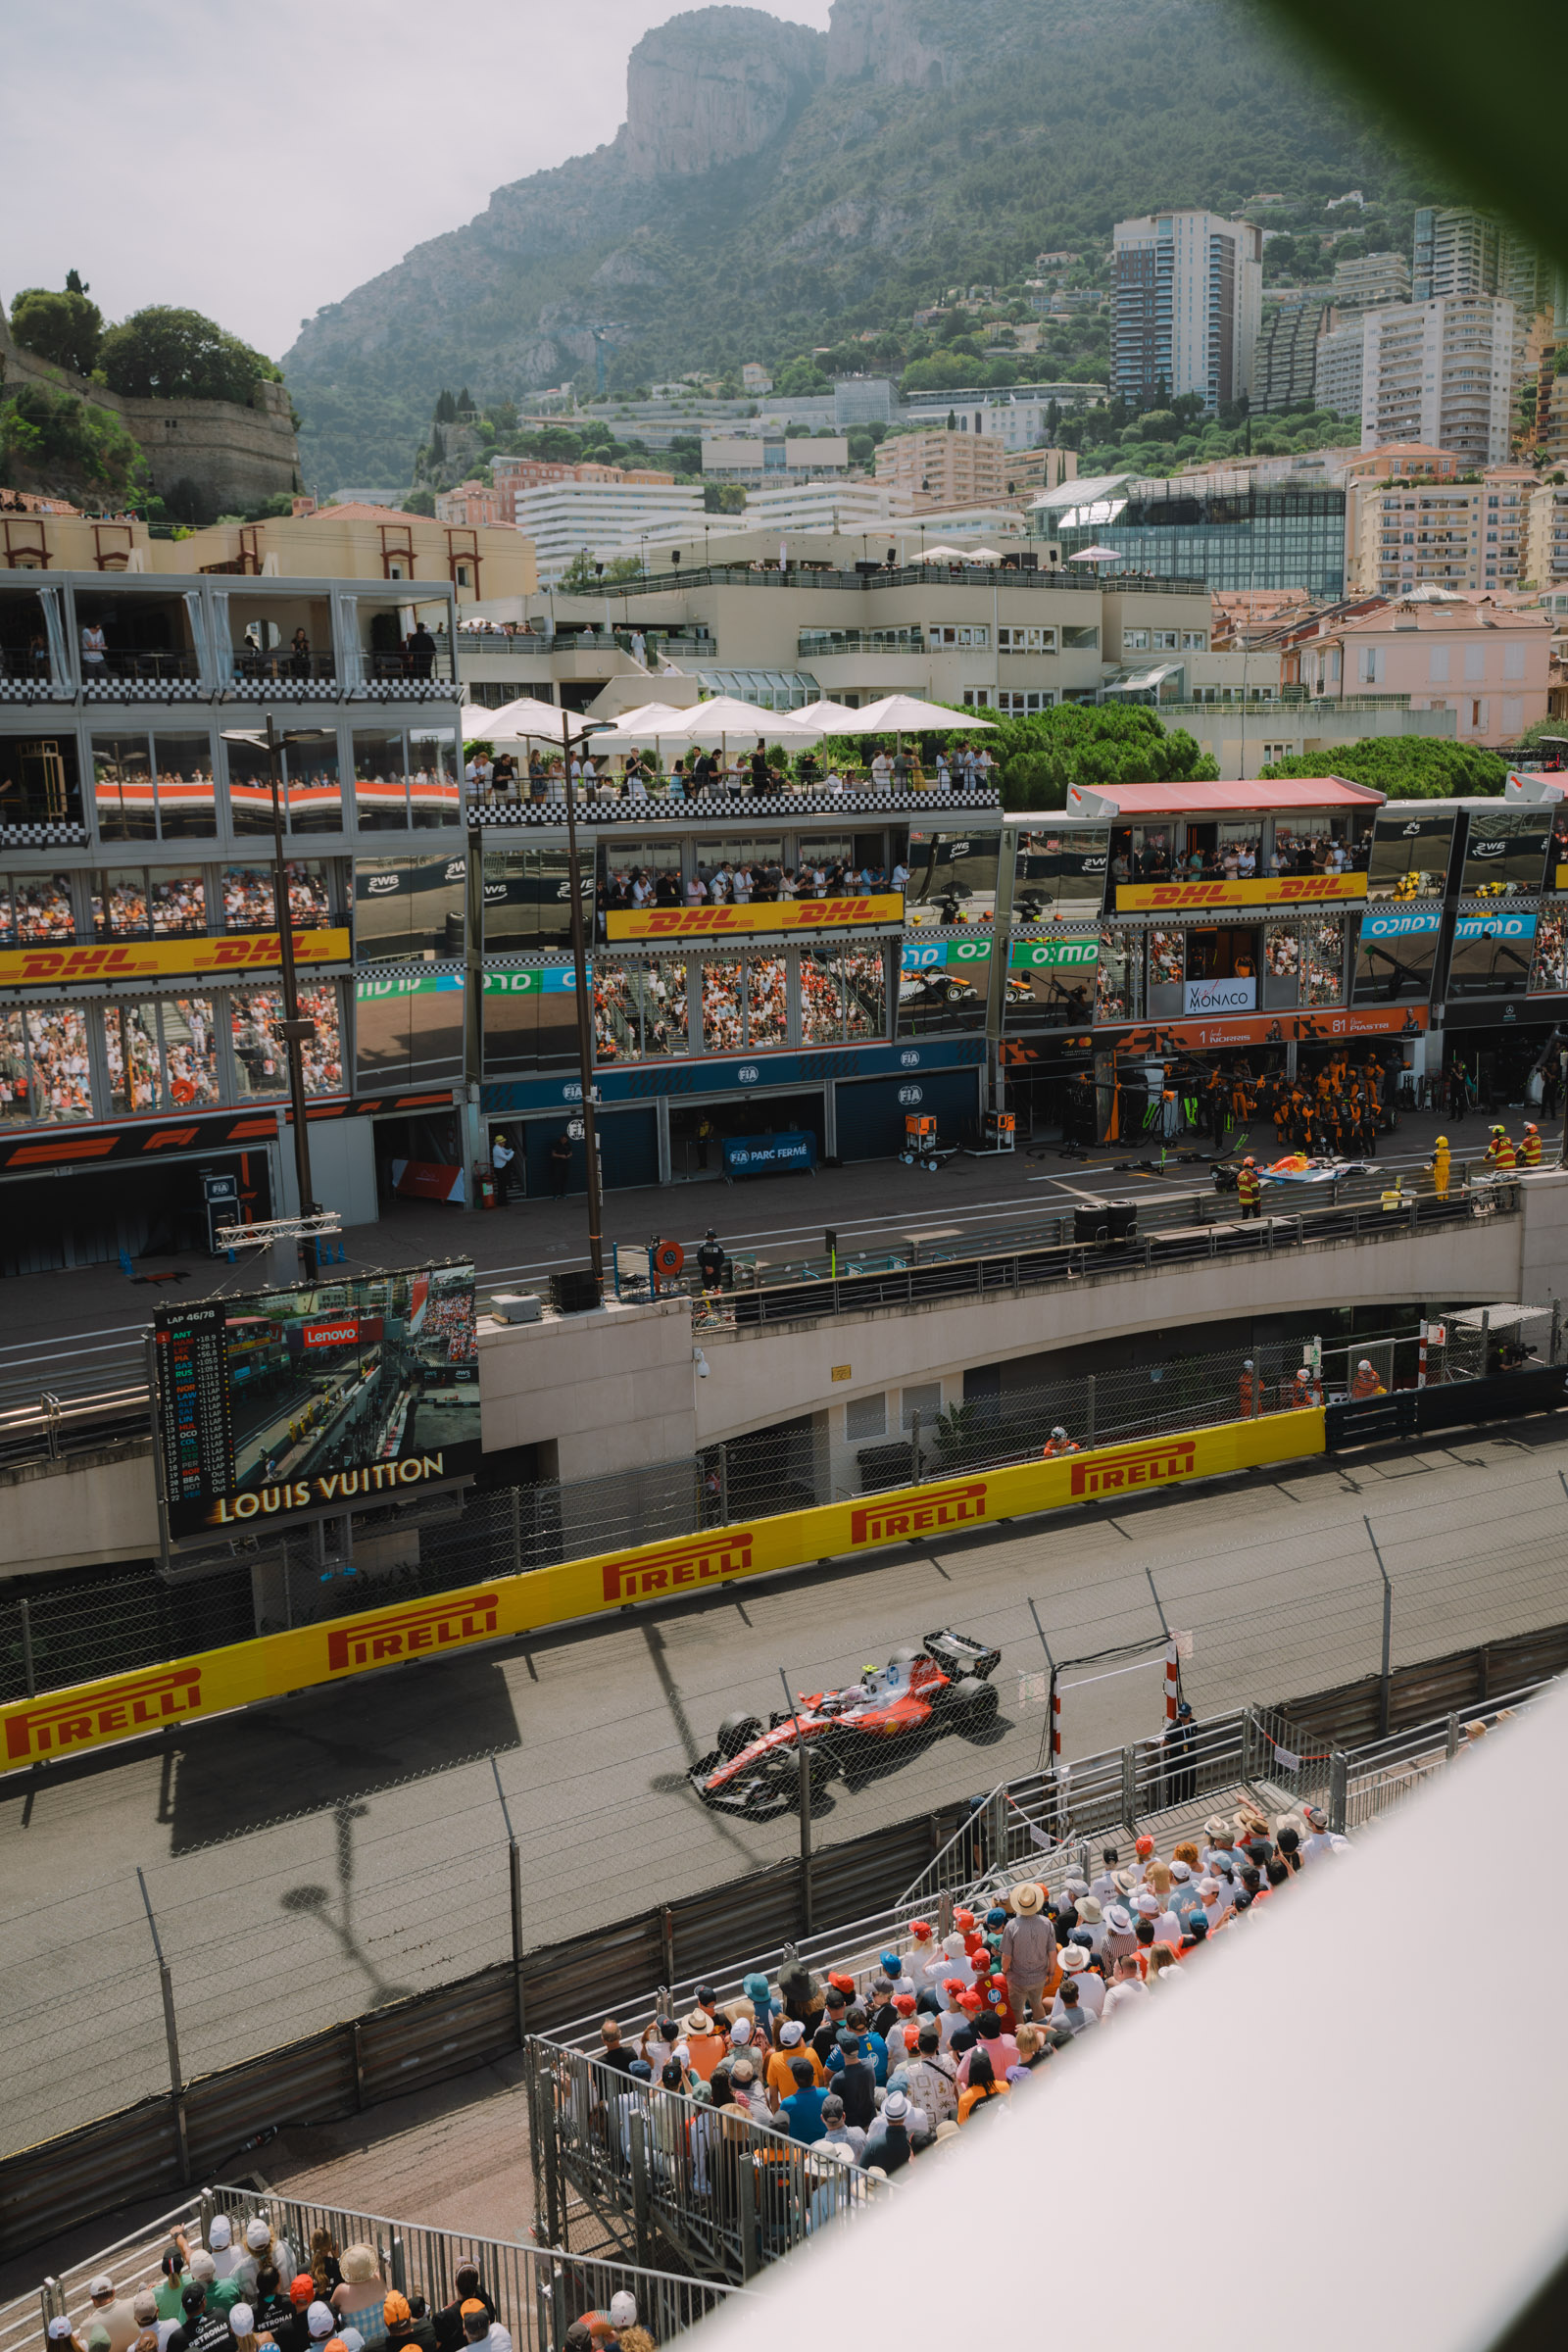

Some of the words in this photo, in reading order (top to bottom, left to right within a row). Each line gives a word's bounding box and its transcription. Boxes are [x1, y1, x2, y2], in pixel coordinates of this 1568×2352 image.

[1151, 884, 1228, 905] DHL
[1279, 878, 1344, 899] DHL
[798, 900, 874, 923] DHL
[647, 908, 738, 933] DHL
[213, 936, 312, 965] DHL
[22, 949, 138, 978] DHL
[1190, 993, 1249, 1009] MONACO
[1332, 1018, 1346, 1033] 81
[1350, 1022, 1390, 1031] PIASTRI
[1200, 1031, 1205, 1044] 1
[1209, 1034, 1251, 1043] NORRIS
[751, 1149, 775, 1161] PARC
[777, 1143, 808, 1158] FERMÉ
[167, 1315, 184, 1325] LAP
[186, 1310, 216, 1321] 46/78
[172, 1330, 193, 1340] ANT
[308, 1328, 356, 1344] Lenovo
[173, 1354, 189, 1363] PIA
[174, 1361, 193, 1370] GAS
[175, 1369, 193, 1378] RUS
[176, 1384, 196, 1394] NOR
[176, 1392, 197, 1401] LAW
[208, 1395, 220, 1403] LAP
[178, 1415, 193, 1424] LIN
[210, 1417, 222, 1426] LAP
[179, 1430, 198, 1439] OCO
[180, 1438, 197, 1446] COL
[211, 1440, 223, 1448] LAP
[181, 1452, 199, 1461] STR
[182, 1467, 200, 1477] BOR
[1071, 1441, 1197, 1495] PIRELLI
[183, 1475, 201, 1484] BEA
[183, 1482, 202, 1492] BOT
[183, 1490, 201, 1498] VER
[212, 1485, 226, 1494] Out
[220, 1481, 311, 1523] LOUIS
[319, 1452, 444, 1499] VUITTON
[852, 1483, 988, 1544] PIRELLI
[603, 1532, 754, 1602] PIRELLI
[327, 1592, 500, 1671] PIRELLI
[4, 1667, 202, 1760] PIRELLI
[257, 2312, 293, 2331] PETRONAS
[188, 2322, 229, 2348] PETRONAS
